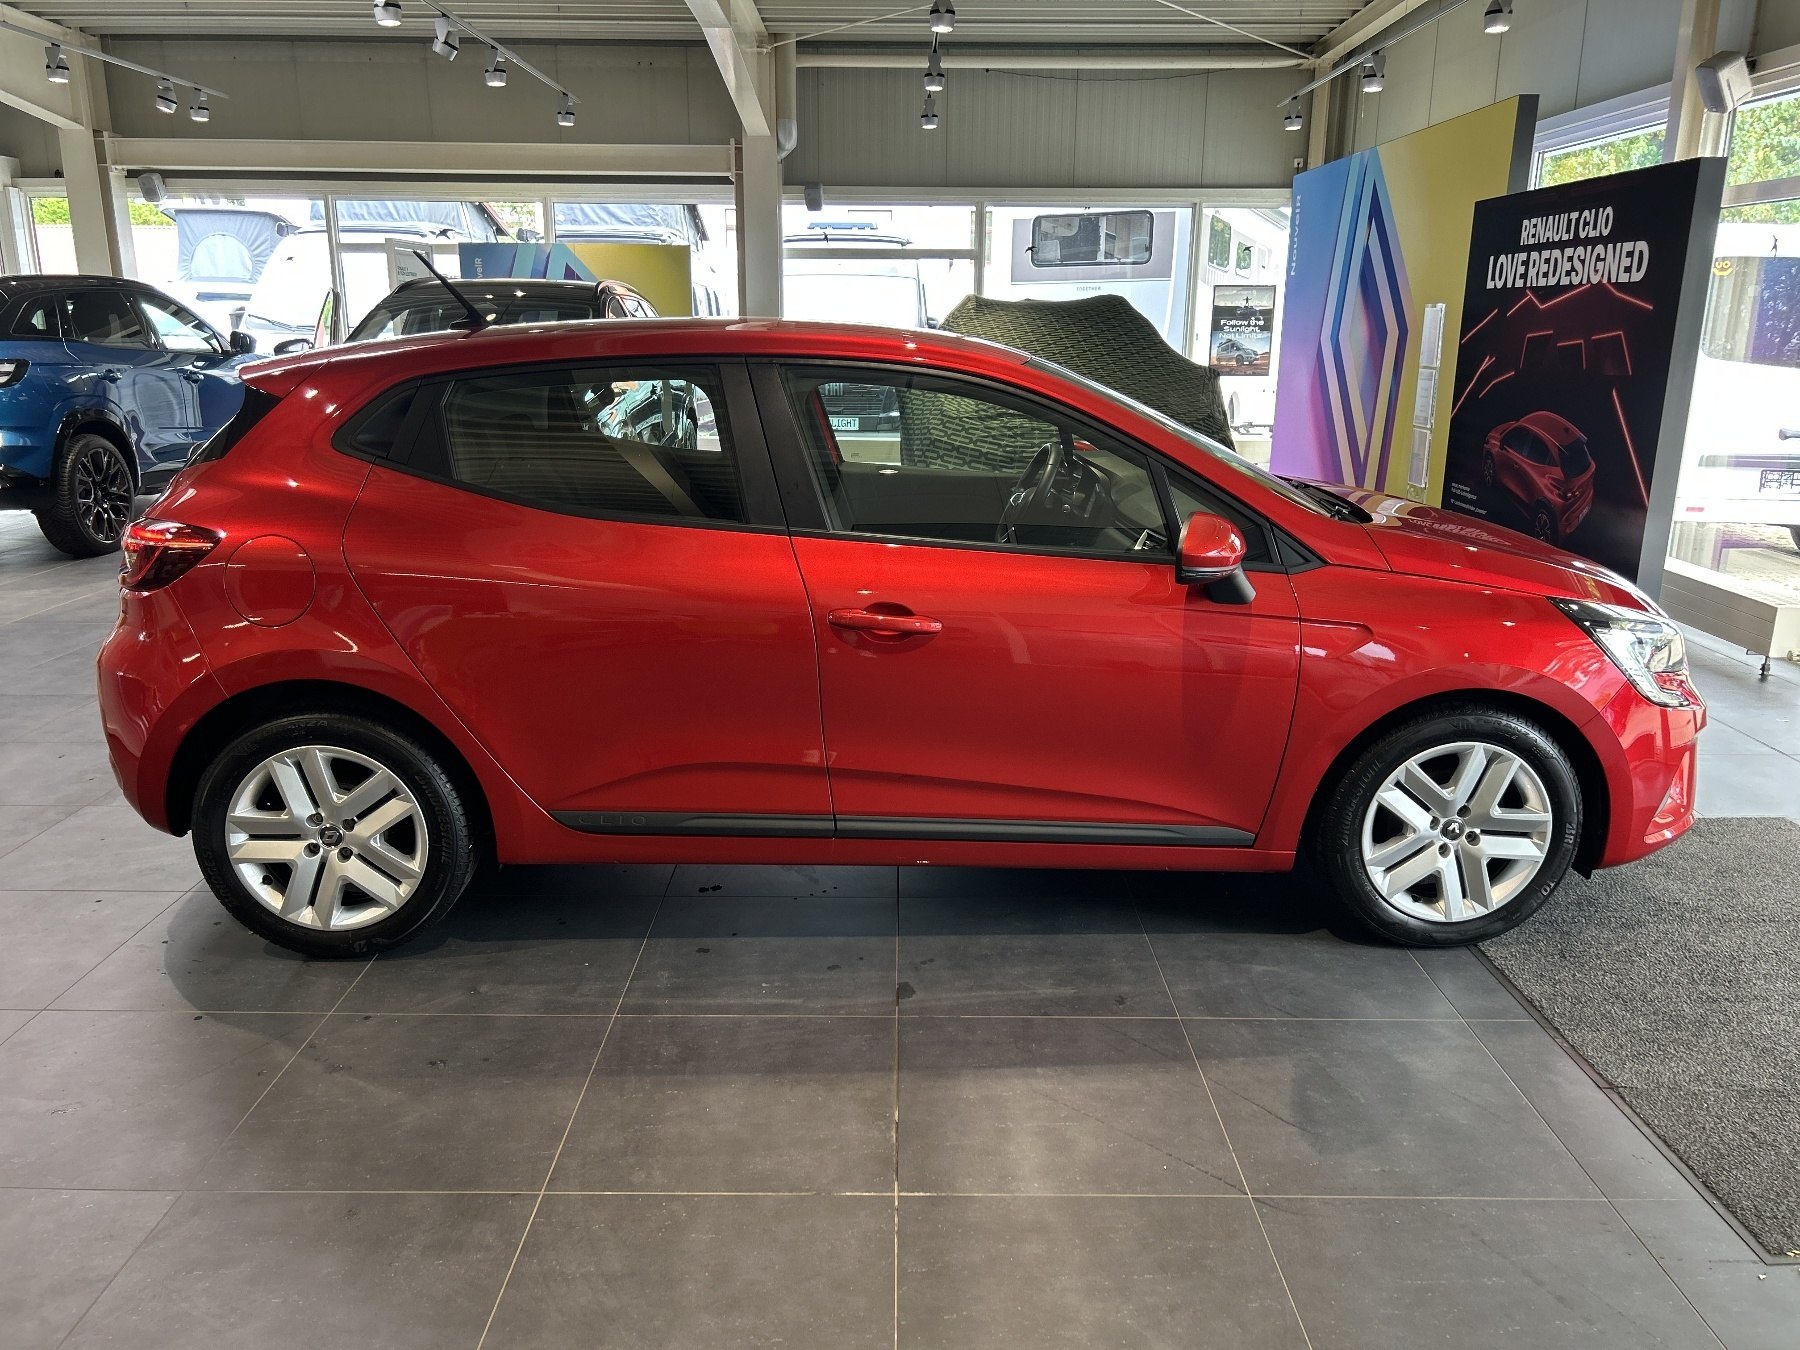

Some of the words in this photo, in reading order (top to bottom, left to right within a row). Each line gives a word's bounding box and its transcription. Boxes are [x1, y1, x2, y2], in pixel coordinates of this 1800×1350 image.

[1520, 211, 1579, 245] RENAULT
[1579, 206, 1614, 239] CLIO
[1486, 252, 1527, 289] LOVE
[1526, 240, 1649, 287] REDESIGNED
[1250, 318, 1265, 326] the
[578, 814, 646, 827] CLIO
